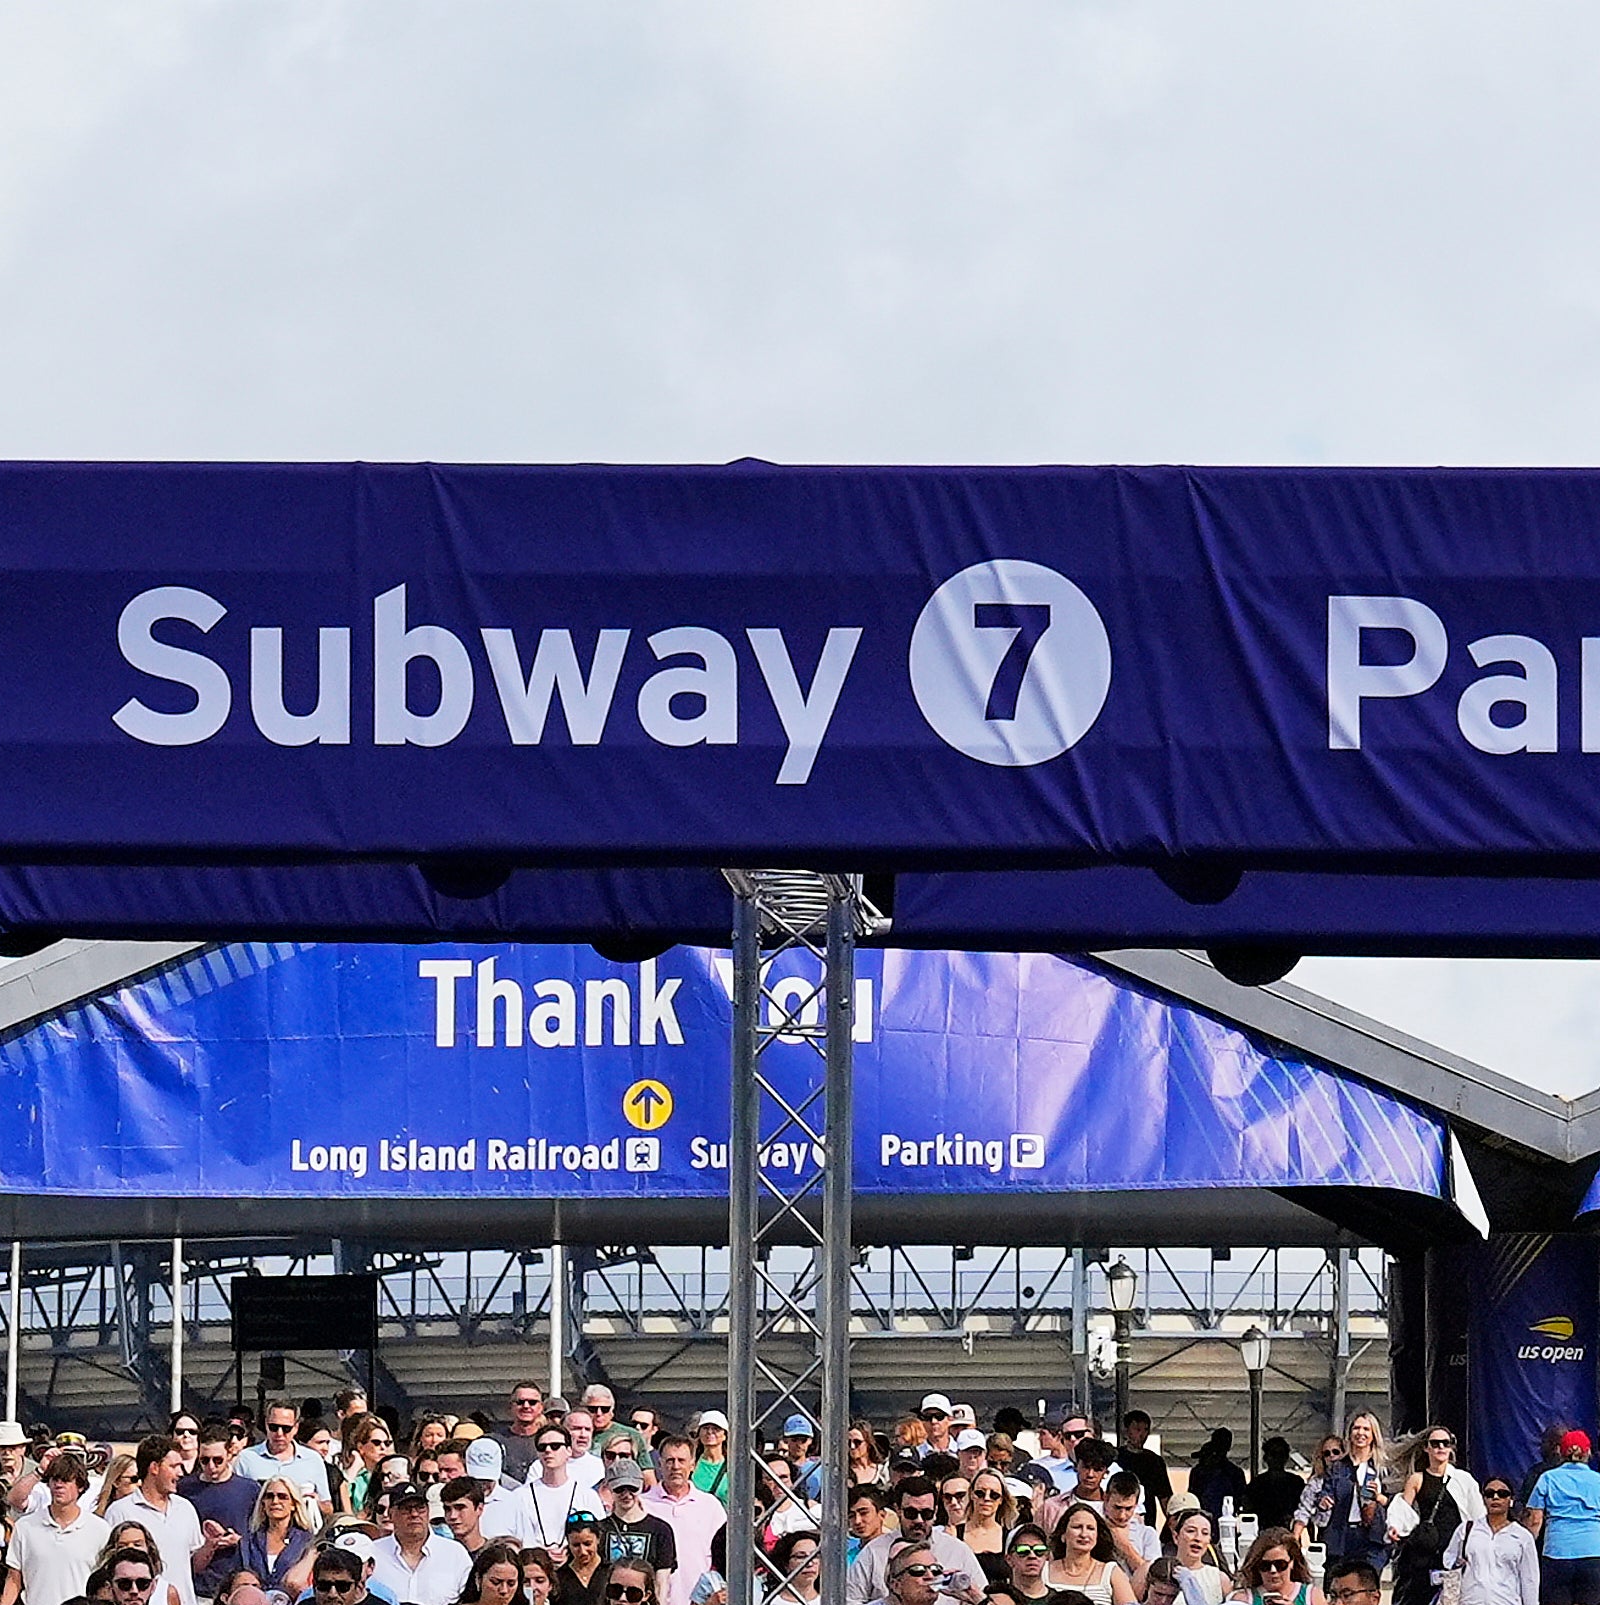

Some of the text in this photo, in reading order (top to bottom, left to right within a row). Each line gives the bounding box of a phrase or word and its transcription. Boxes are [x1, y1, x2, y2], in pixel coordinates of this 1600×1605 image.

[111, 583, 1051, 785] Subway 7
[419, 957, 686, 1048] Thank
[291, 1137, 619, 1179] Long Island Railroad
[881, 1133, 1004, 1174] Parking
